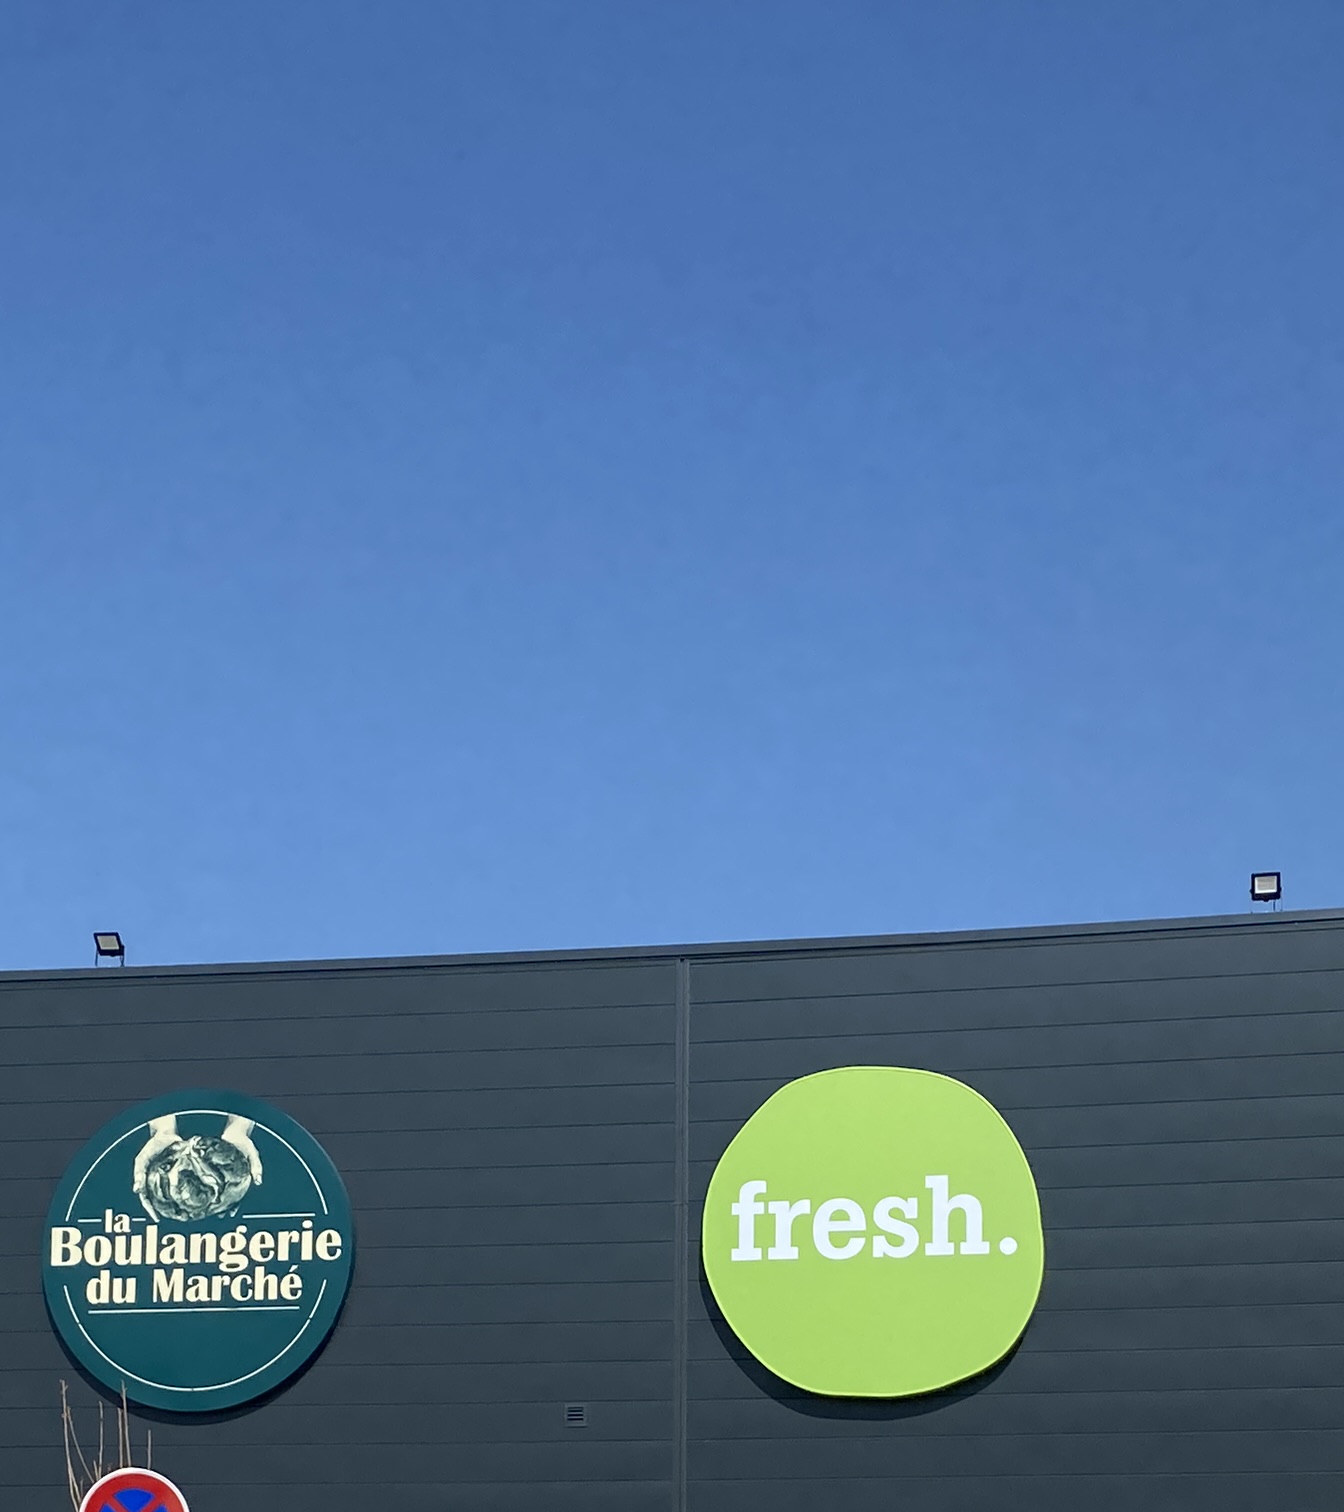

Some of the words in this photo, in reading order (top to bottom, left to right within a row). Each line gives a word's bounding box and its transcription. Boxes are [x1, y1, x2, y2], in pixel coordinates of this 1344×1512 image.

[105, 1209, 131, 1233] la
[731, 1175, 1018, 1261] fresh.
[50, 1220, 342, 1272] Boulangerie
[86, 1270, 136, 1304] du
[153, 1265, 303, 1303] Marché
